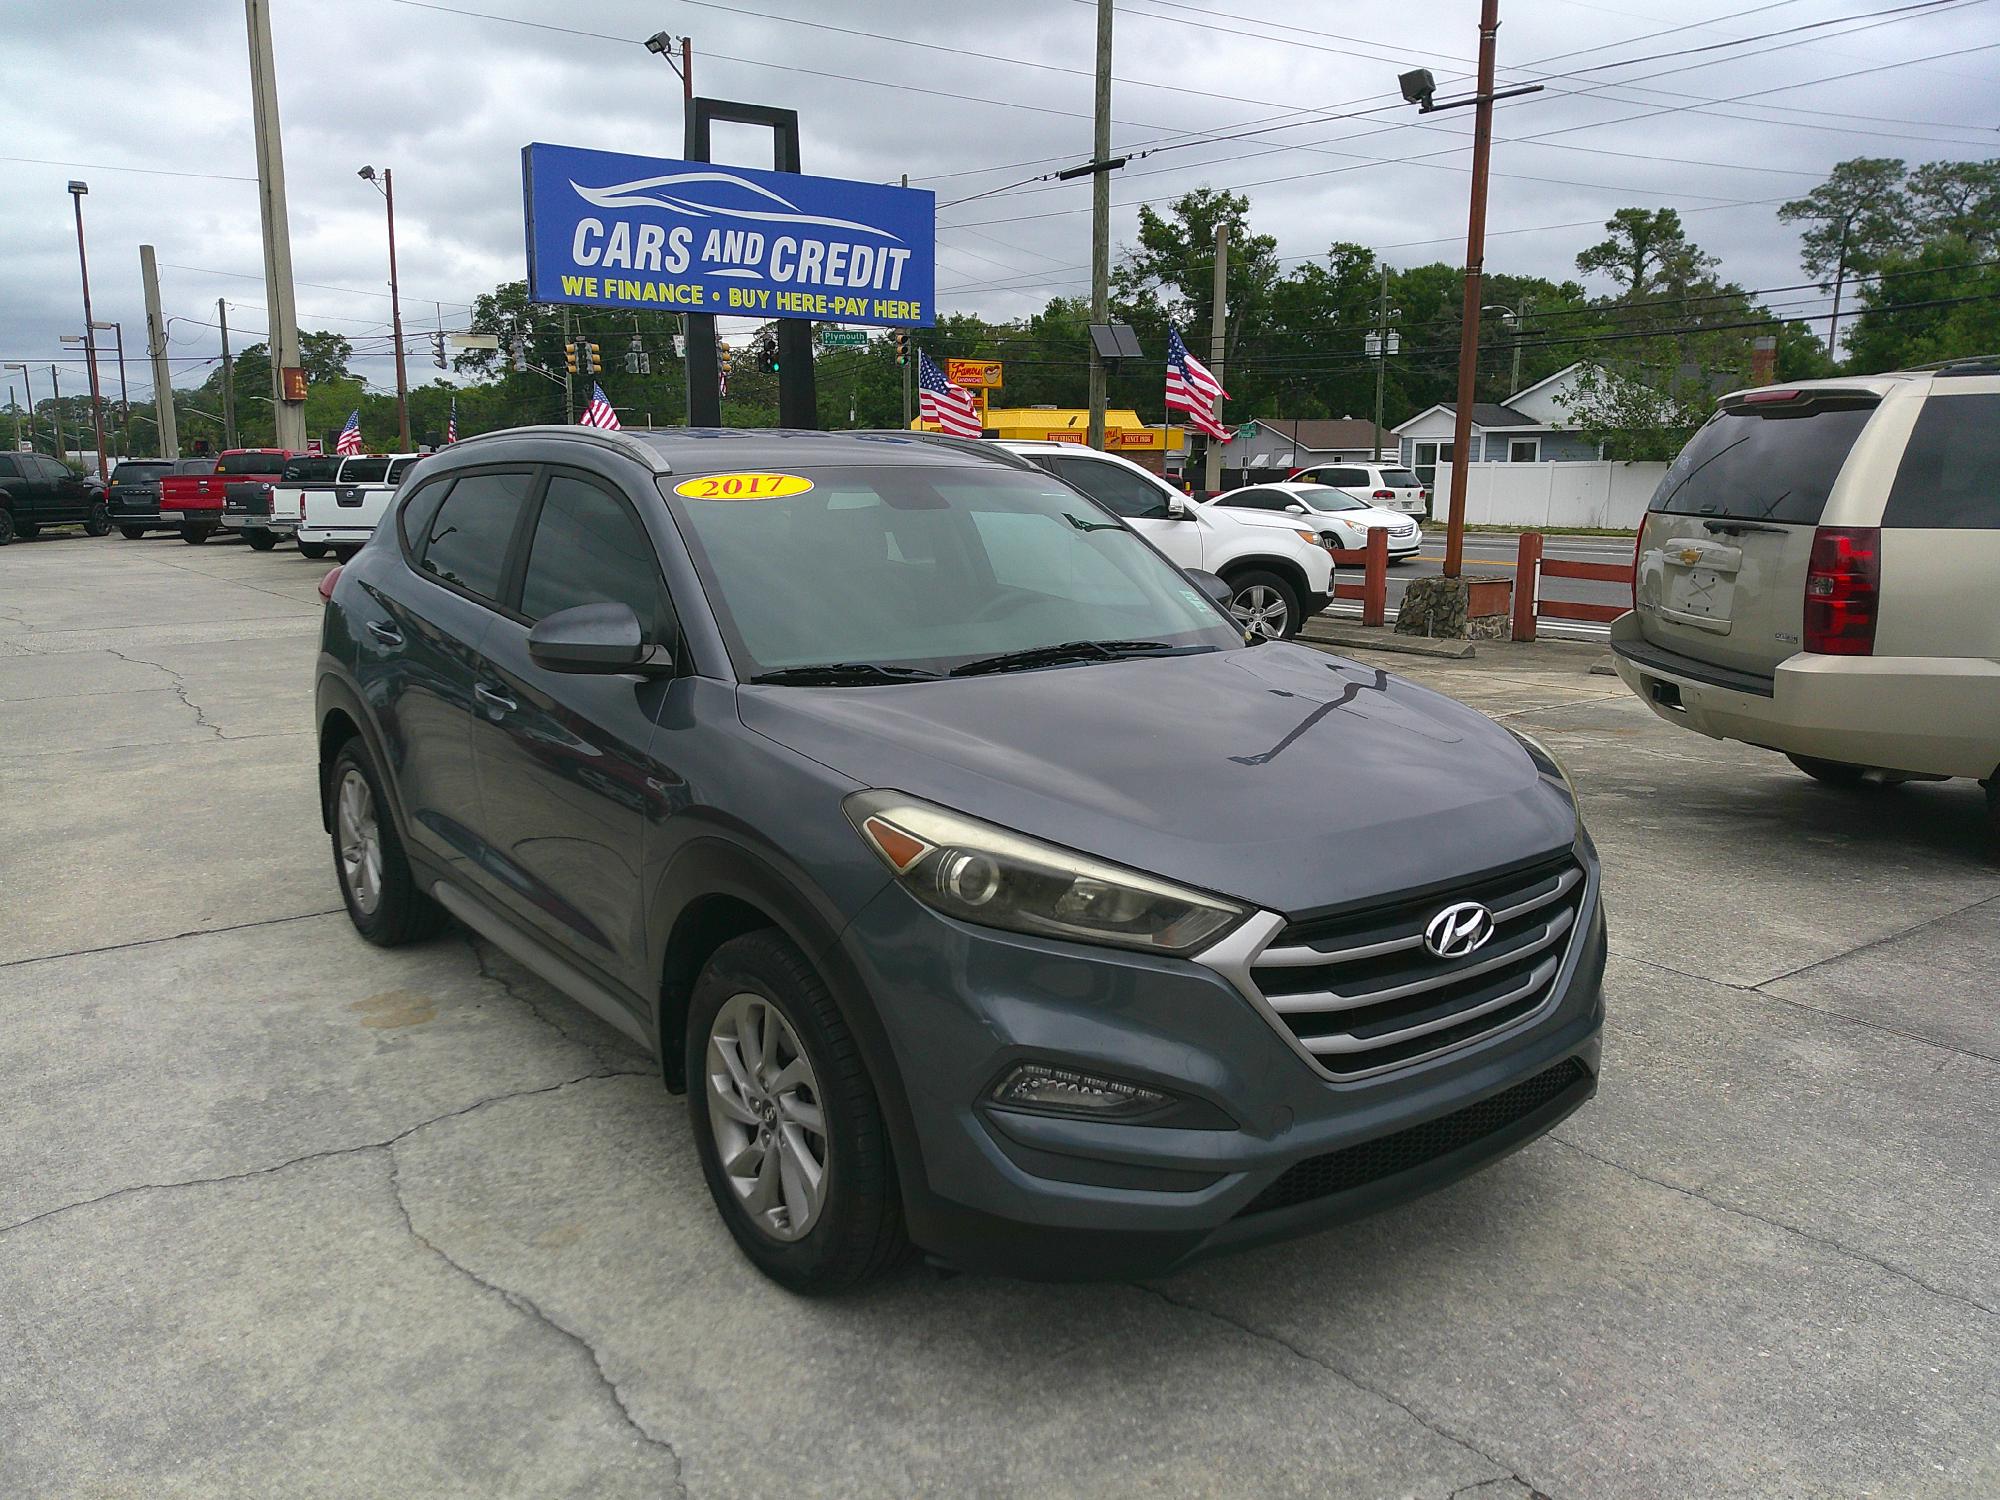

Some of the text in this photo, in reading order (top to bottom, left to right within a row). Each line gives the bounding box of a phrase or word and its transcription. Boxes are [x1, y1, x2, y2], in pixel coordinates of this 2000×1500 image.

[572, 217, 911, 291] CARS AND CREDIT
[561, 275, 598, 298] WE
[604, 278, 704, 305] FINANCE
[729, 287, 770, 309] BUY
[874, 299, 921, 320] HERE
[824, 332, 865, 341] Plymouth
[701, 476, 785, 497] 2017
